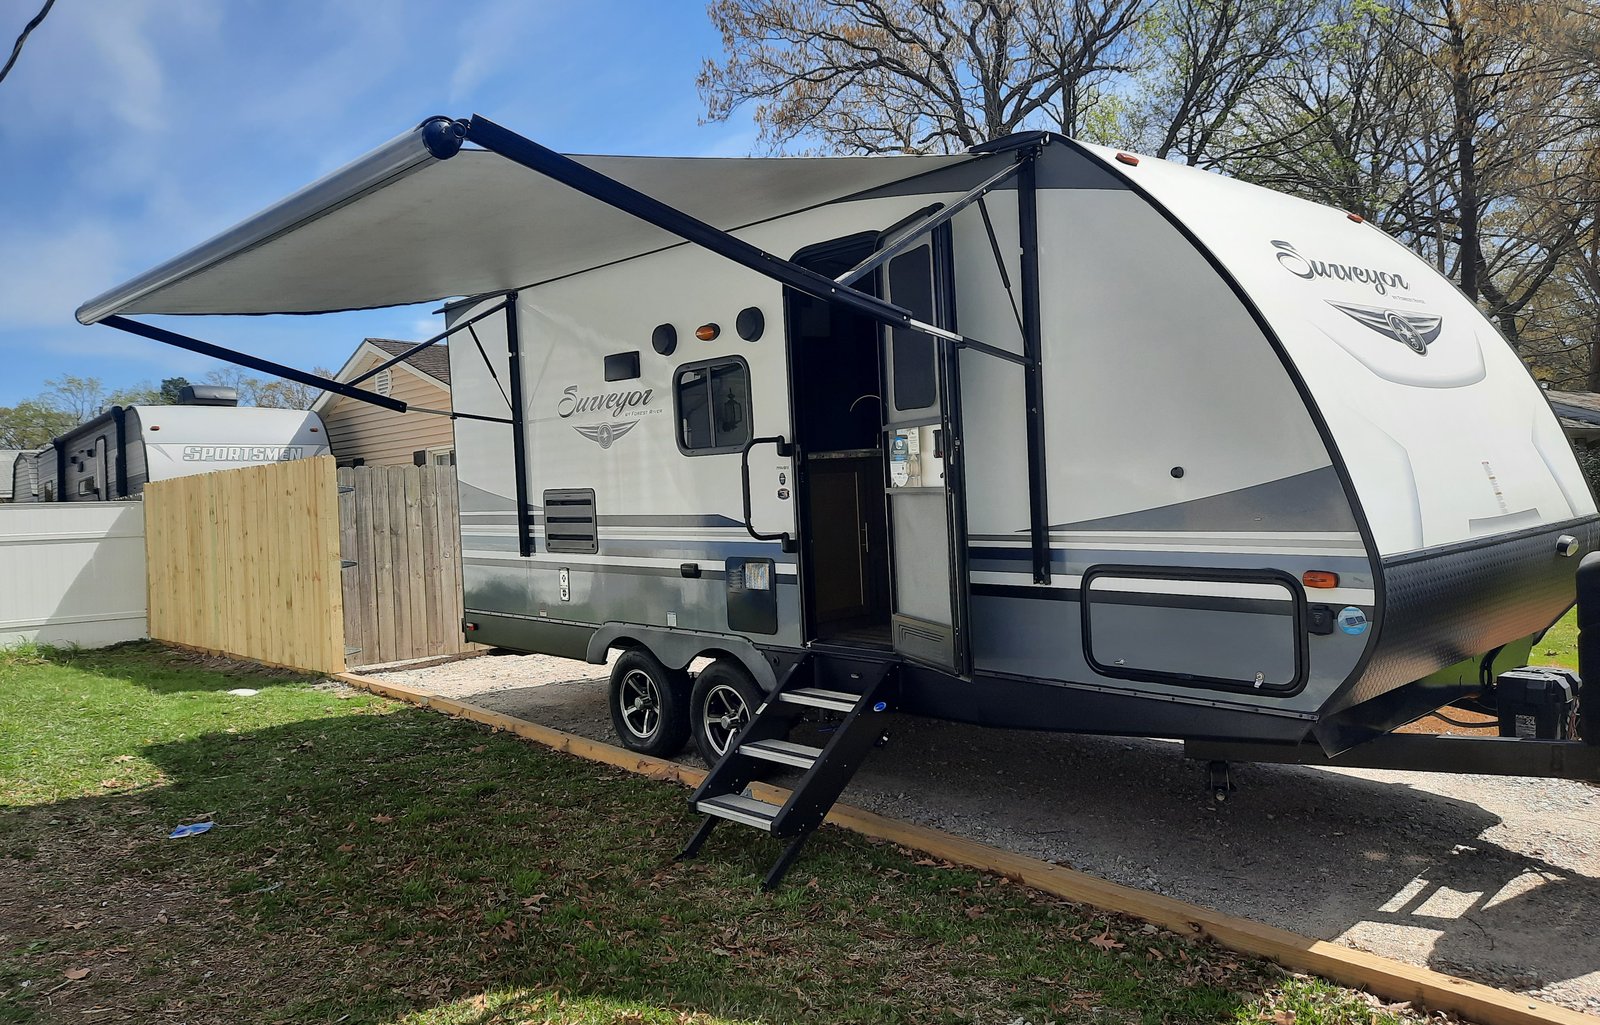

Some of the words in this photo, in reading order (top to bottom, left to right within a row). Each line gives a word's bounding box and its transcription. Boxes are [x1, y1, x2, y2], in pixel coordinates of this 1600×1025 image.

[1270, 240, 1409, 295] Surveyor
[558, 385, 653, 418] Surveyor
[183, 446, 303, 462] SPORTSMEN
